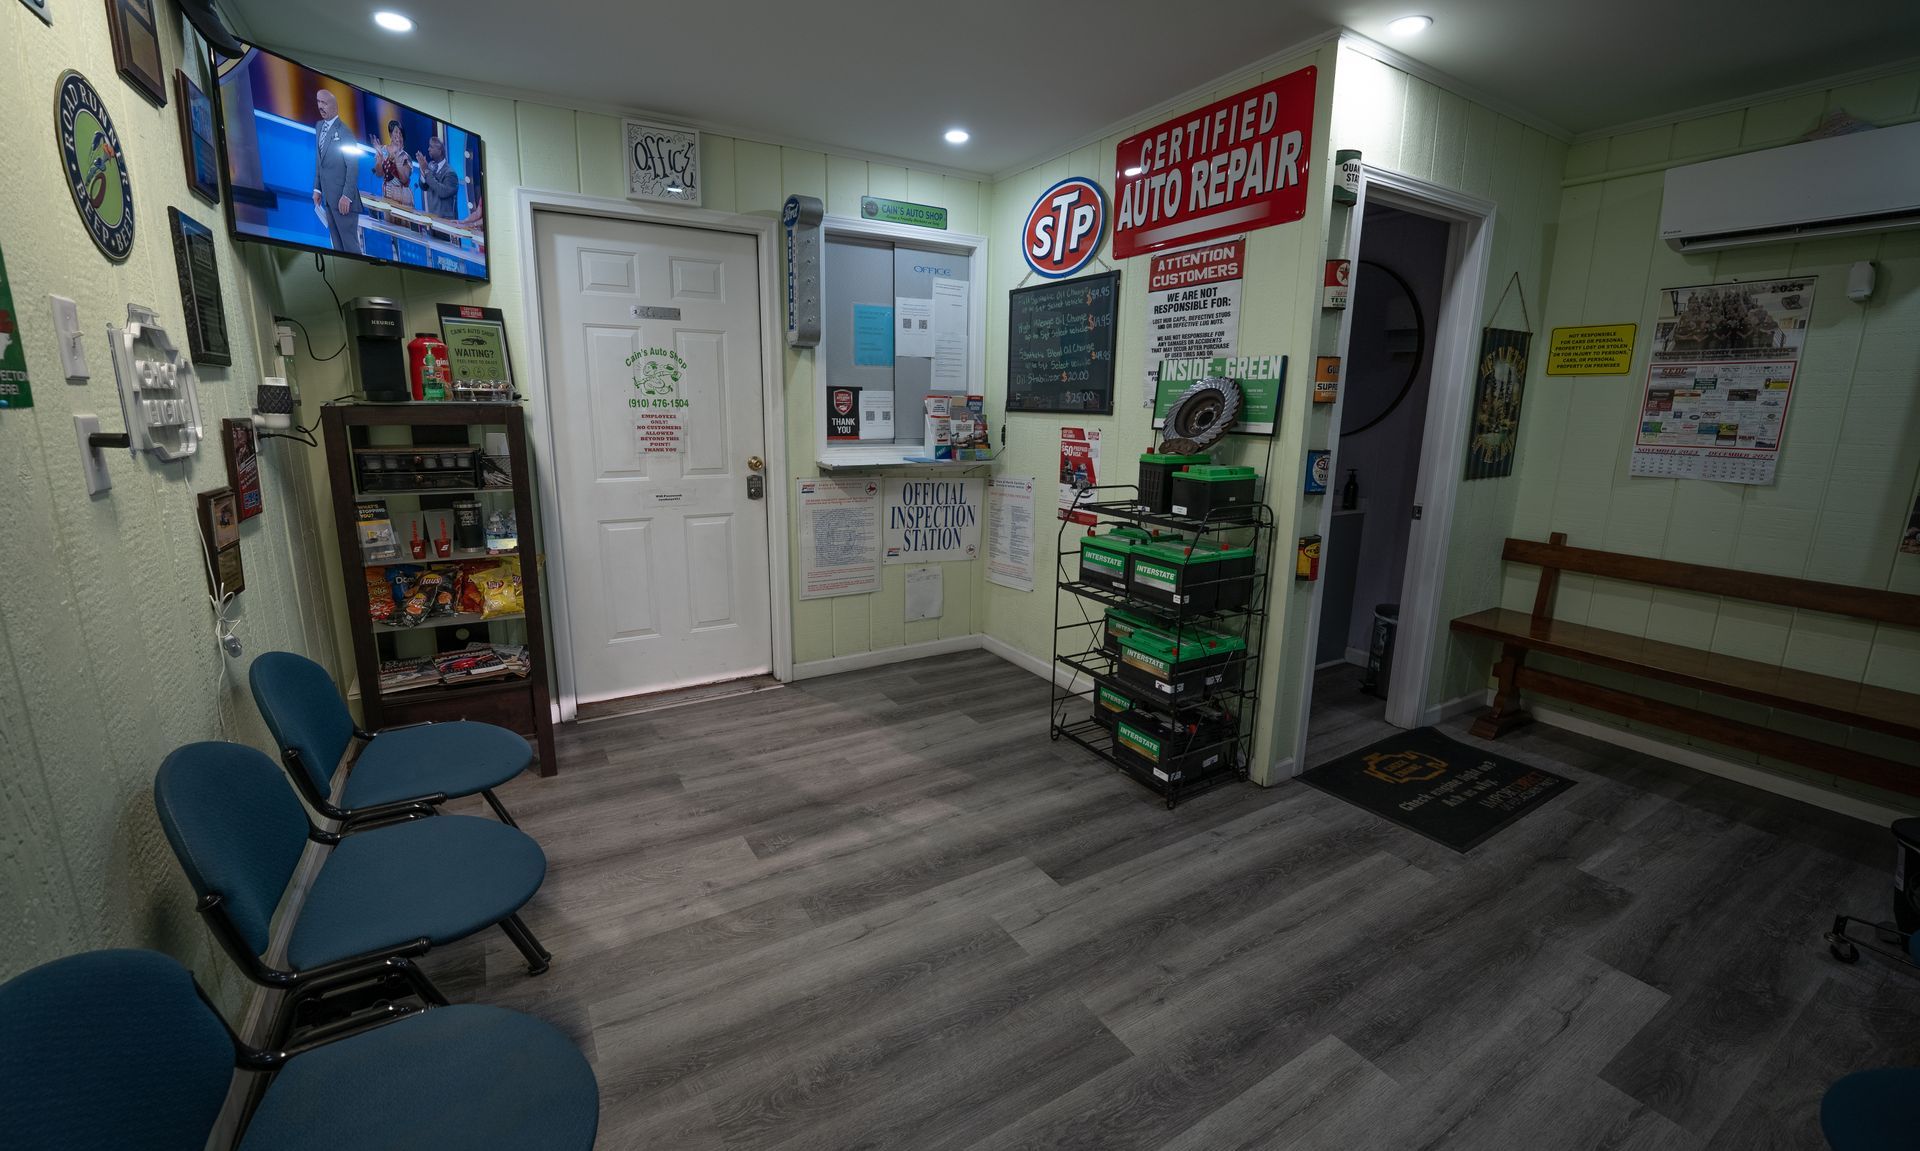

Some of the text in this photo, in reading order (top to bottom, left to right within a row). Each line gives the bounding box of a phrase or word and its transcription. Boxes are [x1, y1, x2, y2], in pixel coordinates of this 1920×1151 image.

[62, 83, 79, 151] ROAD
[1139, 90, 1279, 179] CERTIFIED
[1116, 130, 1304, 232] AUTO REPAIR
[75, 182, 134, 252] BEEP BEEP
[881, 204, 904, 216] CAIN'S
[906, 208, 924, 219] AUTO
[926, 211, 944, 222] SHOP
[1031, 189, 1096, 264] STP
[1158, 246, 1235, 272] ATTENTION
[913, 265, 951, 276] OFFICE
[1152, 262, 1238, 288] CUSTOMERS
[1167, 287, 1218, 303] WE ARE NOT
[1154, 297, 1232, 315] RESPONSIBLE FOR:
[1181, 331, 1214, 340] RESPONSIBLE
[454, 347, 495, 358] WAITING?
[625, 347, 688, 370] Cain's Auto Shop
[1161, 358, 1214, 382] INSIDE
[1225, 355, 1282, 381] GREEN
[628, 398, 689, 408] (910) 476-1504
[832, 417, 856, 426] THANK
[837, 425, 852, 434] YOU
[902, 481, 968, 506] OFFICIAL
[889, 504, 977, 530] INSPECTION
[903, 527, 962, 552] STATION
[1085, 550, 1123, 567] INTERSTATE
[1136, 564, 1176, 581] INTERSTATE
[1126, 648, 1165, 669] INTERSTATE
[1120, 726, 1160, 752] INTERSTATE
[1398, 792, 1434, 811] Check
[1440, 793, 1468, 808] Ask
